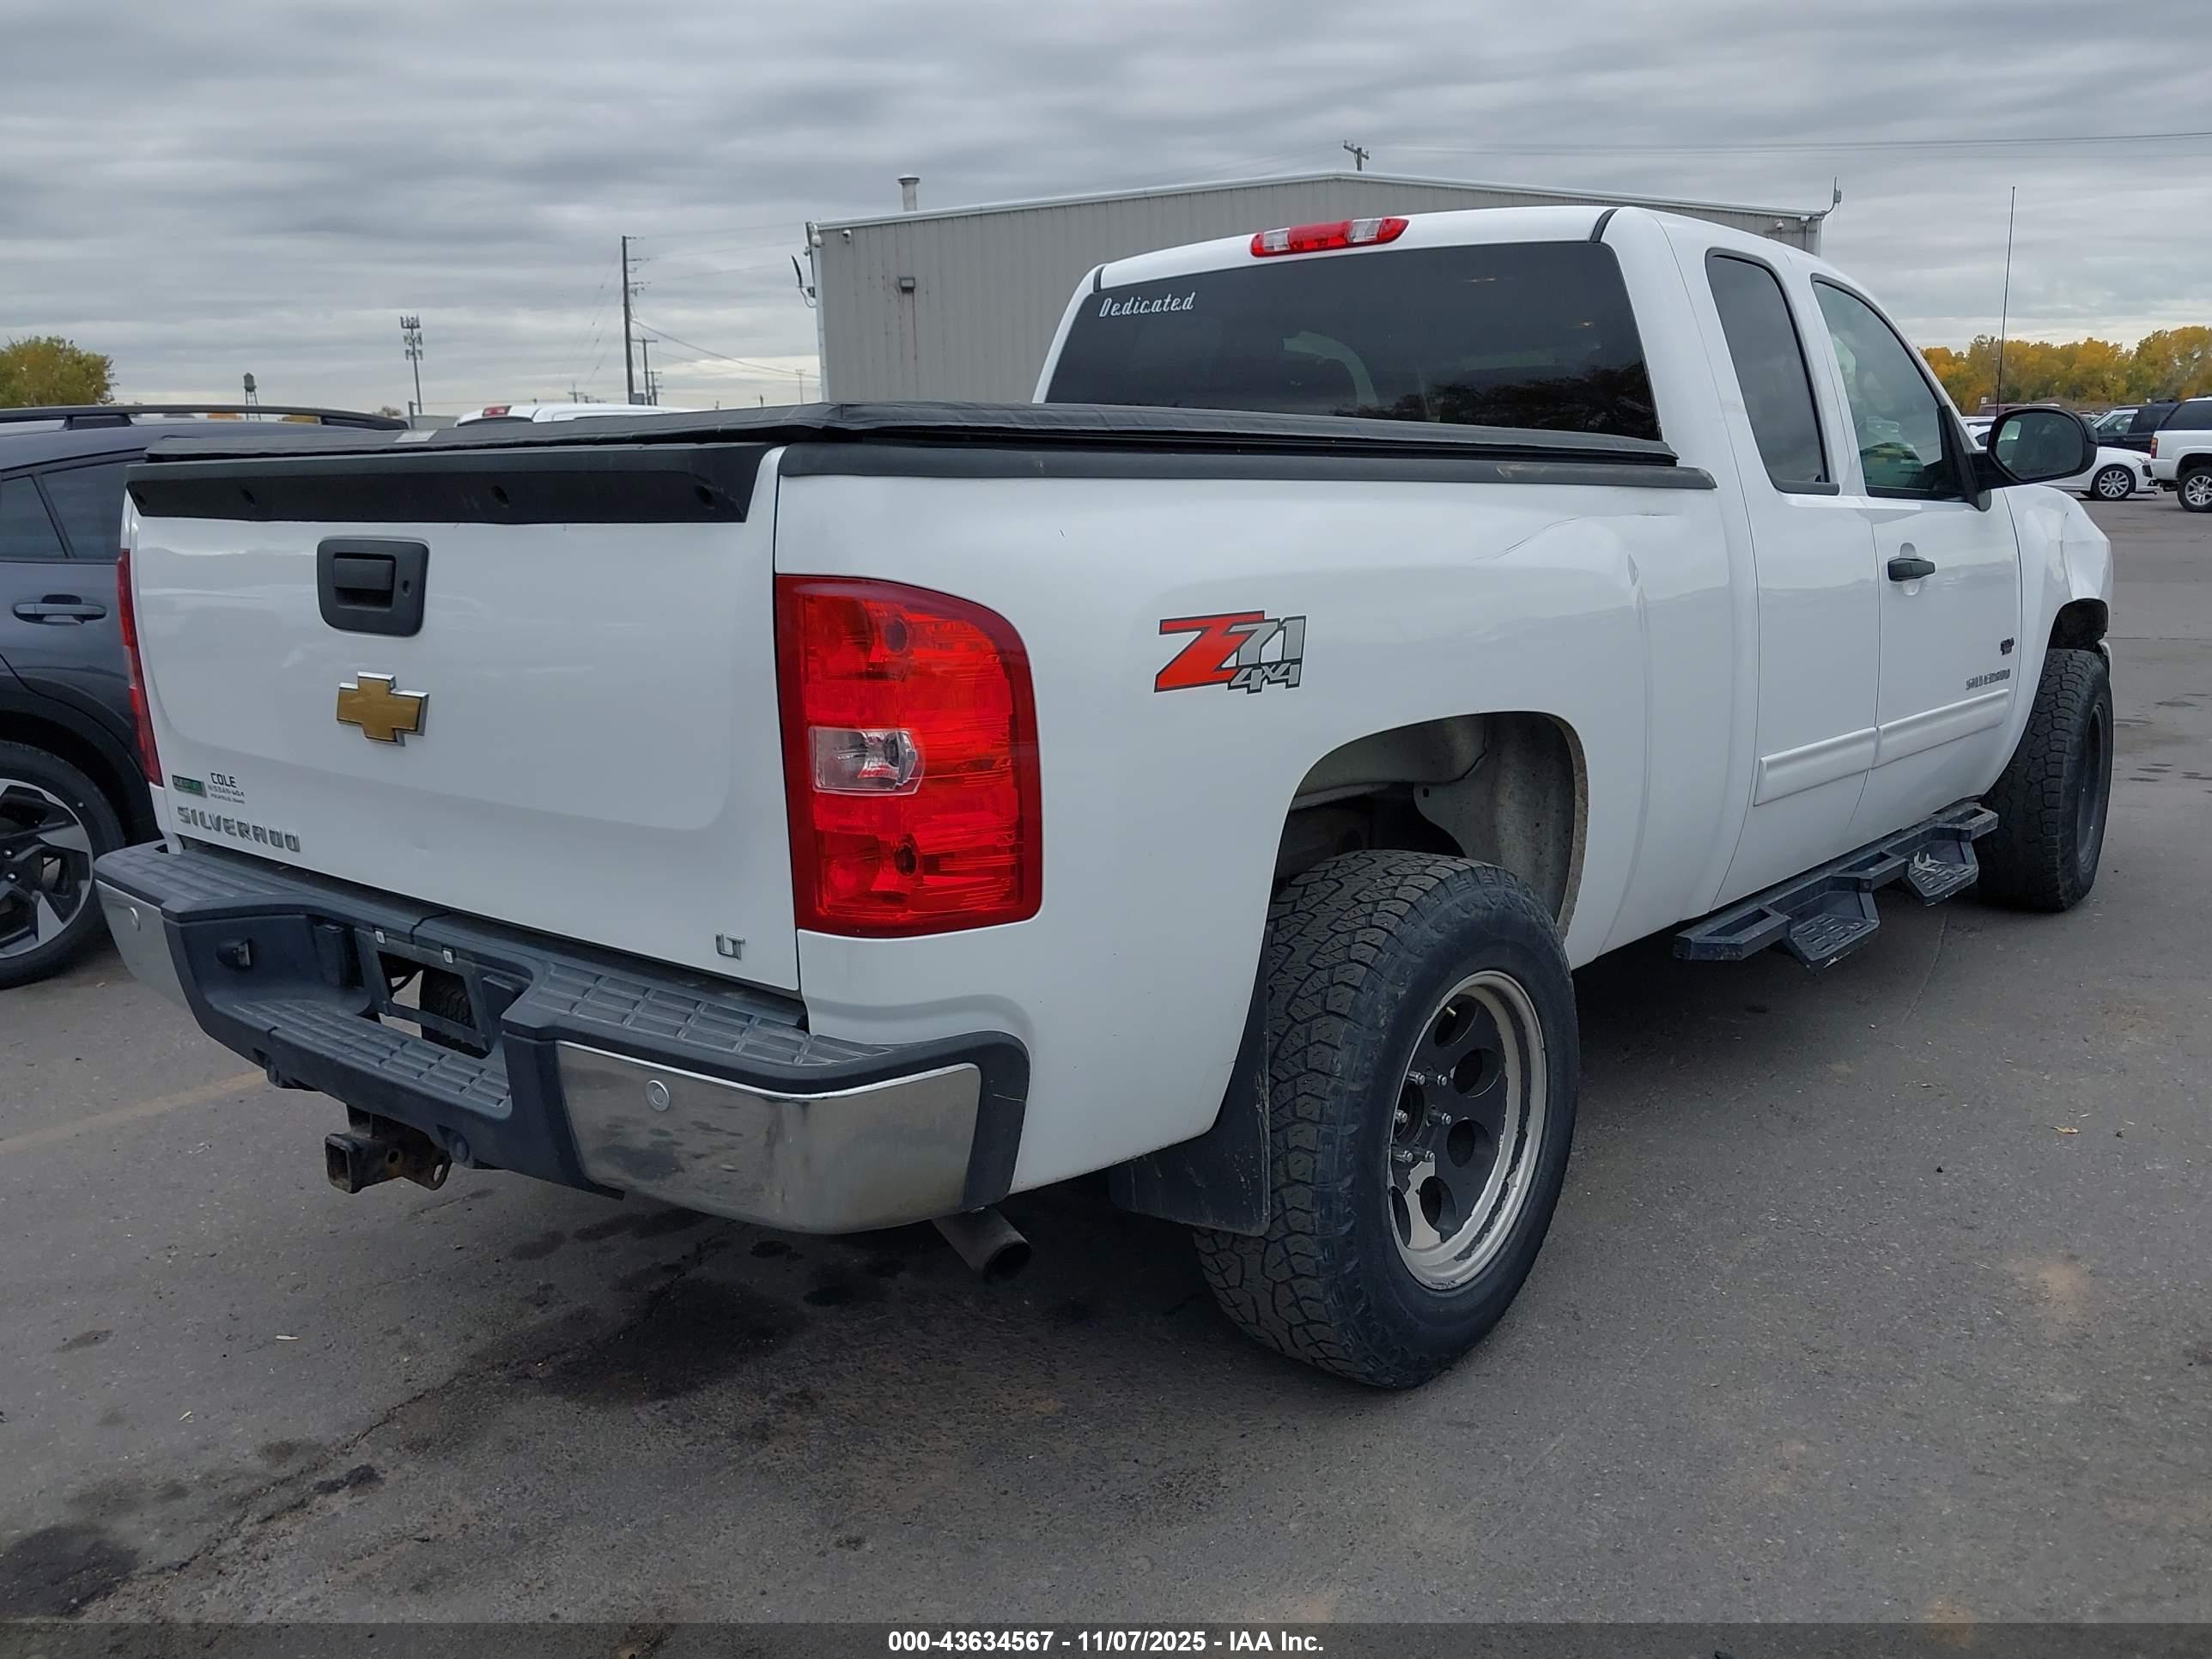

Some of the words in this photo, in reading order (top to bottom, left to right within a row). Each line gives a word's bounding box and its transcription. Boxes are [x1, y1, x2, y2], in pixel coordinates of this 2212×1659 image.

[1098, 291, 1196, 318] Dedicated
[1153, 611, 1306, 693] Z71
[210, 772, 237, 788] COLE
[177, 805, 301, 853] SILVERADO
[715, 933, 746, 961] LT
